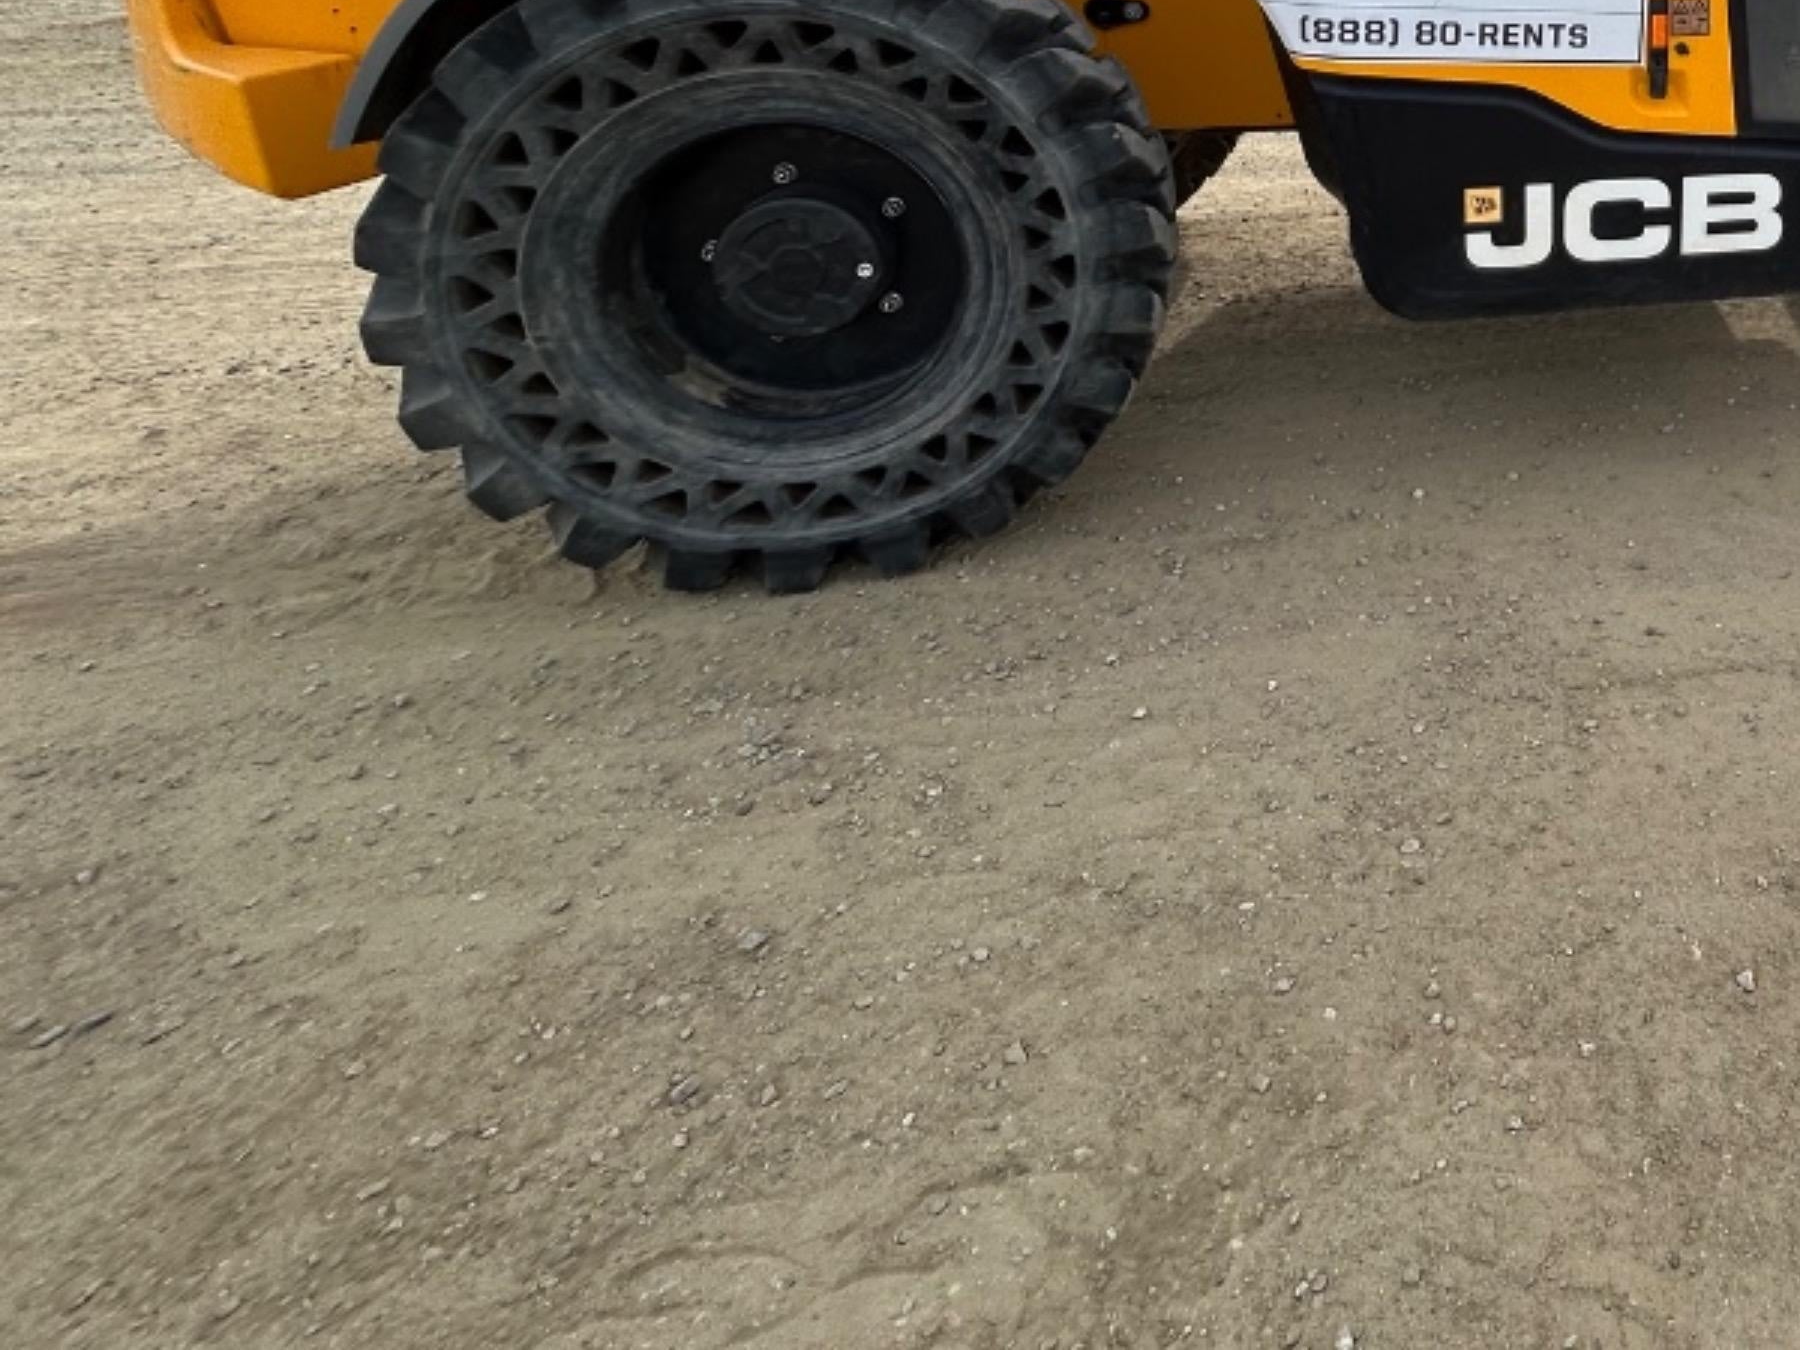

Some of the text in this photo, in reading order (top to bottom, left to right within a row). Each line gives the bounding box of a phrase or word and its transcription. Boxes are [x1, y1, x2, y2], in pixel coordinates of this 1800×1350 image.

[1299, 15, 1589, 50] (888) 80-RENTS
[1465, 172, 1784, 269] JCB
